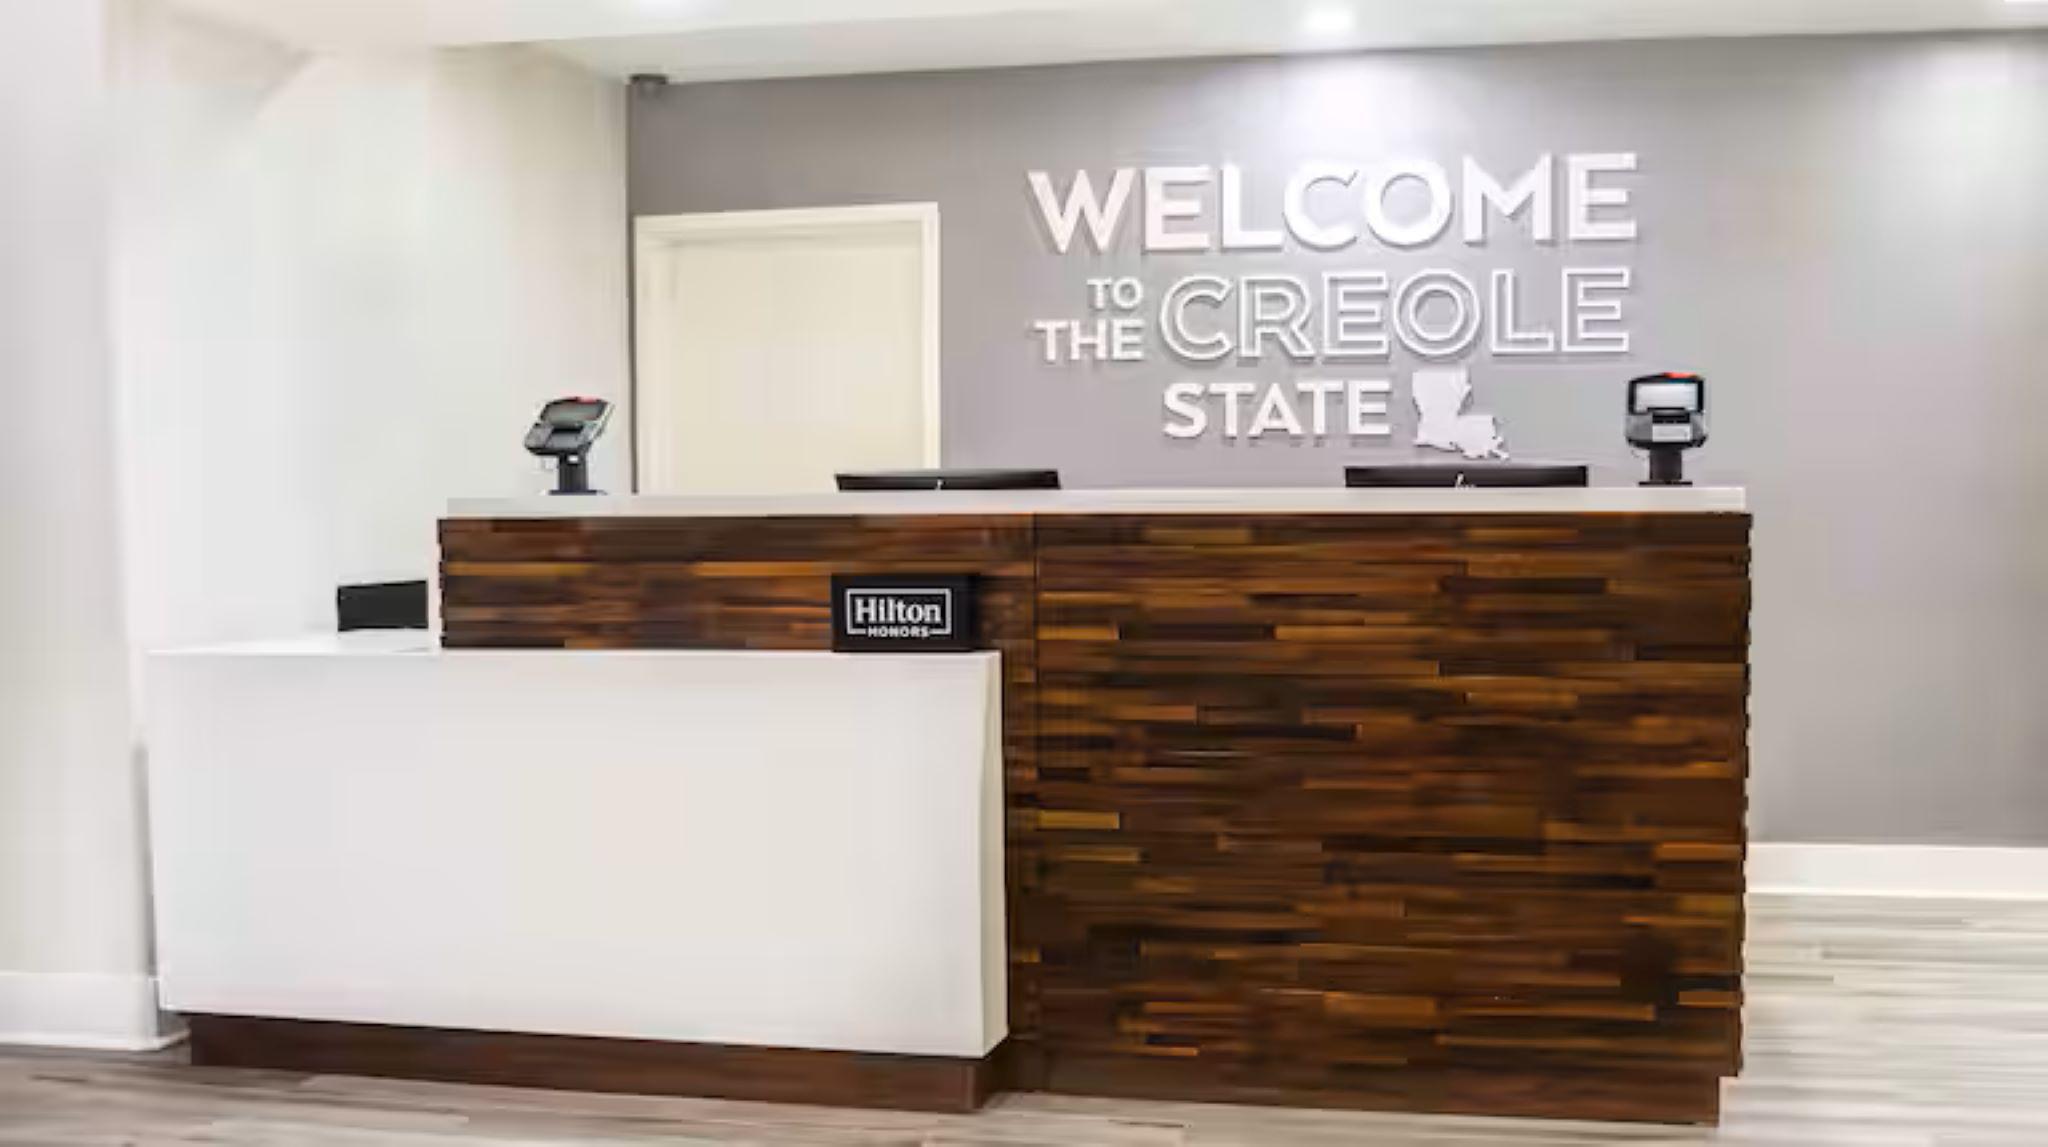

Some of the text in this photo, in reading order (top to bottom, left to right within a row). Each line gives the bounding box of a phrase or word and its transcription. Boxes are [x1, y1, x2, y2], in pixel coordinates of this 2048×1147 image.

[1027, 152, 1638, 253] WELCOME
[1087, 277, 1144, 310] TO
[1160, 266, 1632, 361] CREOLE
[1035, 319, 1145, 361] THE
[1162, 380, 1393, 438] STATE
[854, 596, 942, 624] Hilton
[867, 625, 930, 638] HONORS
